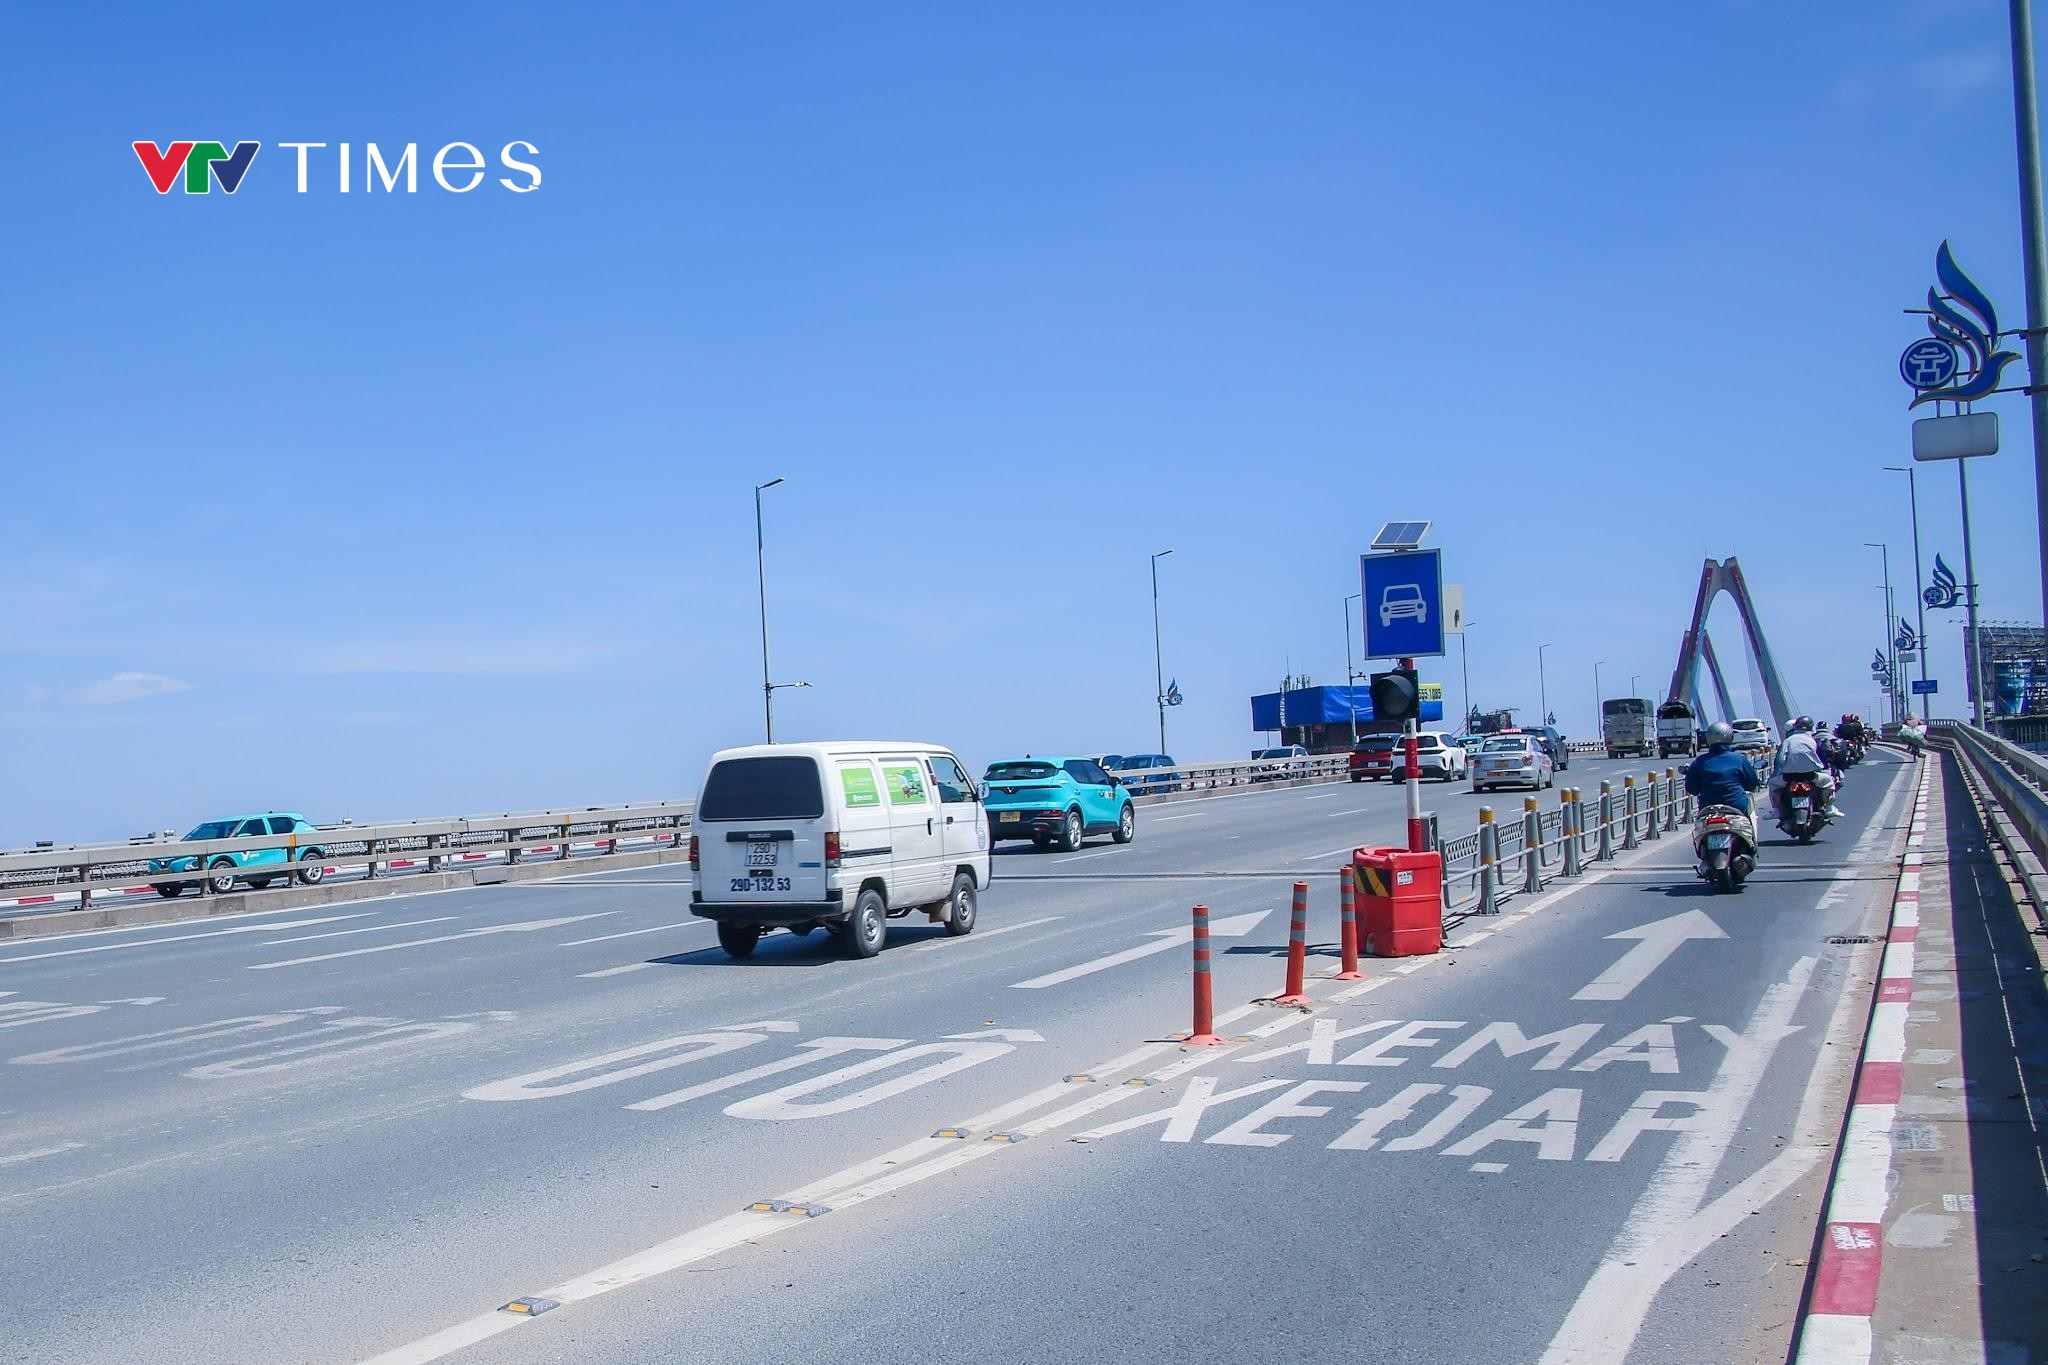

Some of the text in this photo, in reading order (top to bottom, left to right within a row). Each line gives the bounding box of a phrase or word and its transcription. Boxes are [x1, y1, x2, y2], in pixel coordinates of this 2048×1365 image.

[753, 843, 771, 854] 29D
[731, 877, 791, 892] 29D-132 53
[1232, 1015, 1807, 1075] XE MÁY
[1072, 1076, 1370, 1147] XE
